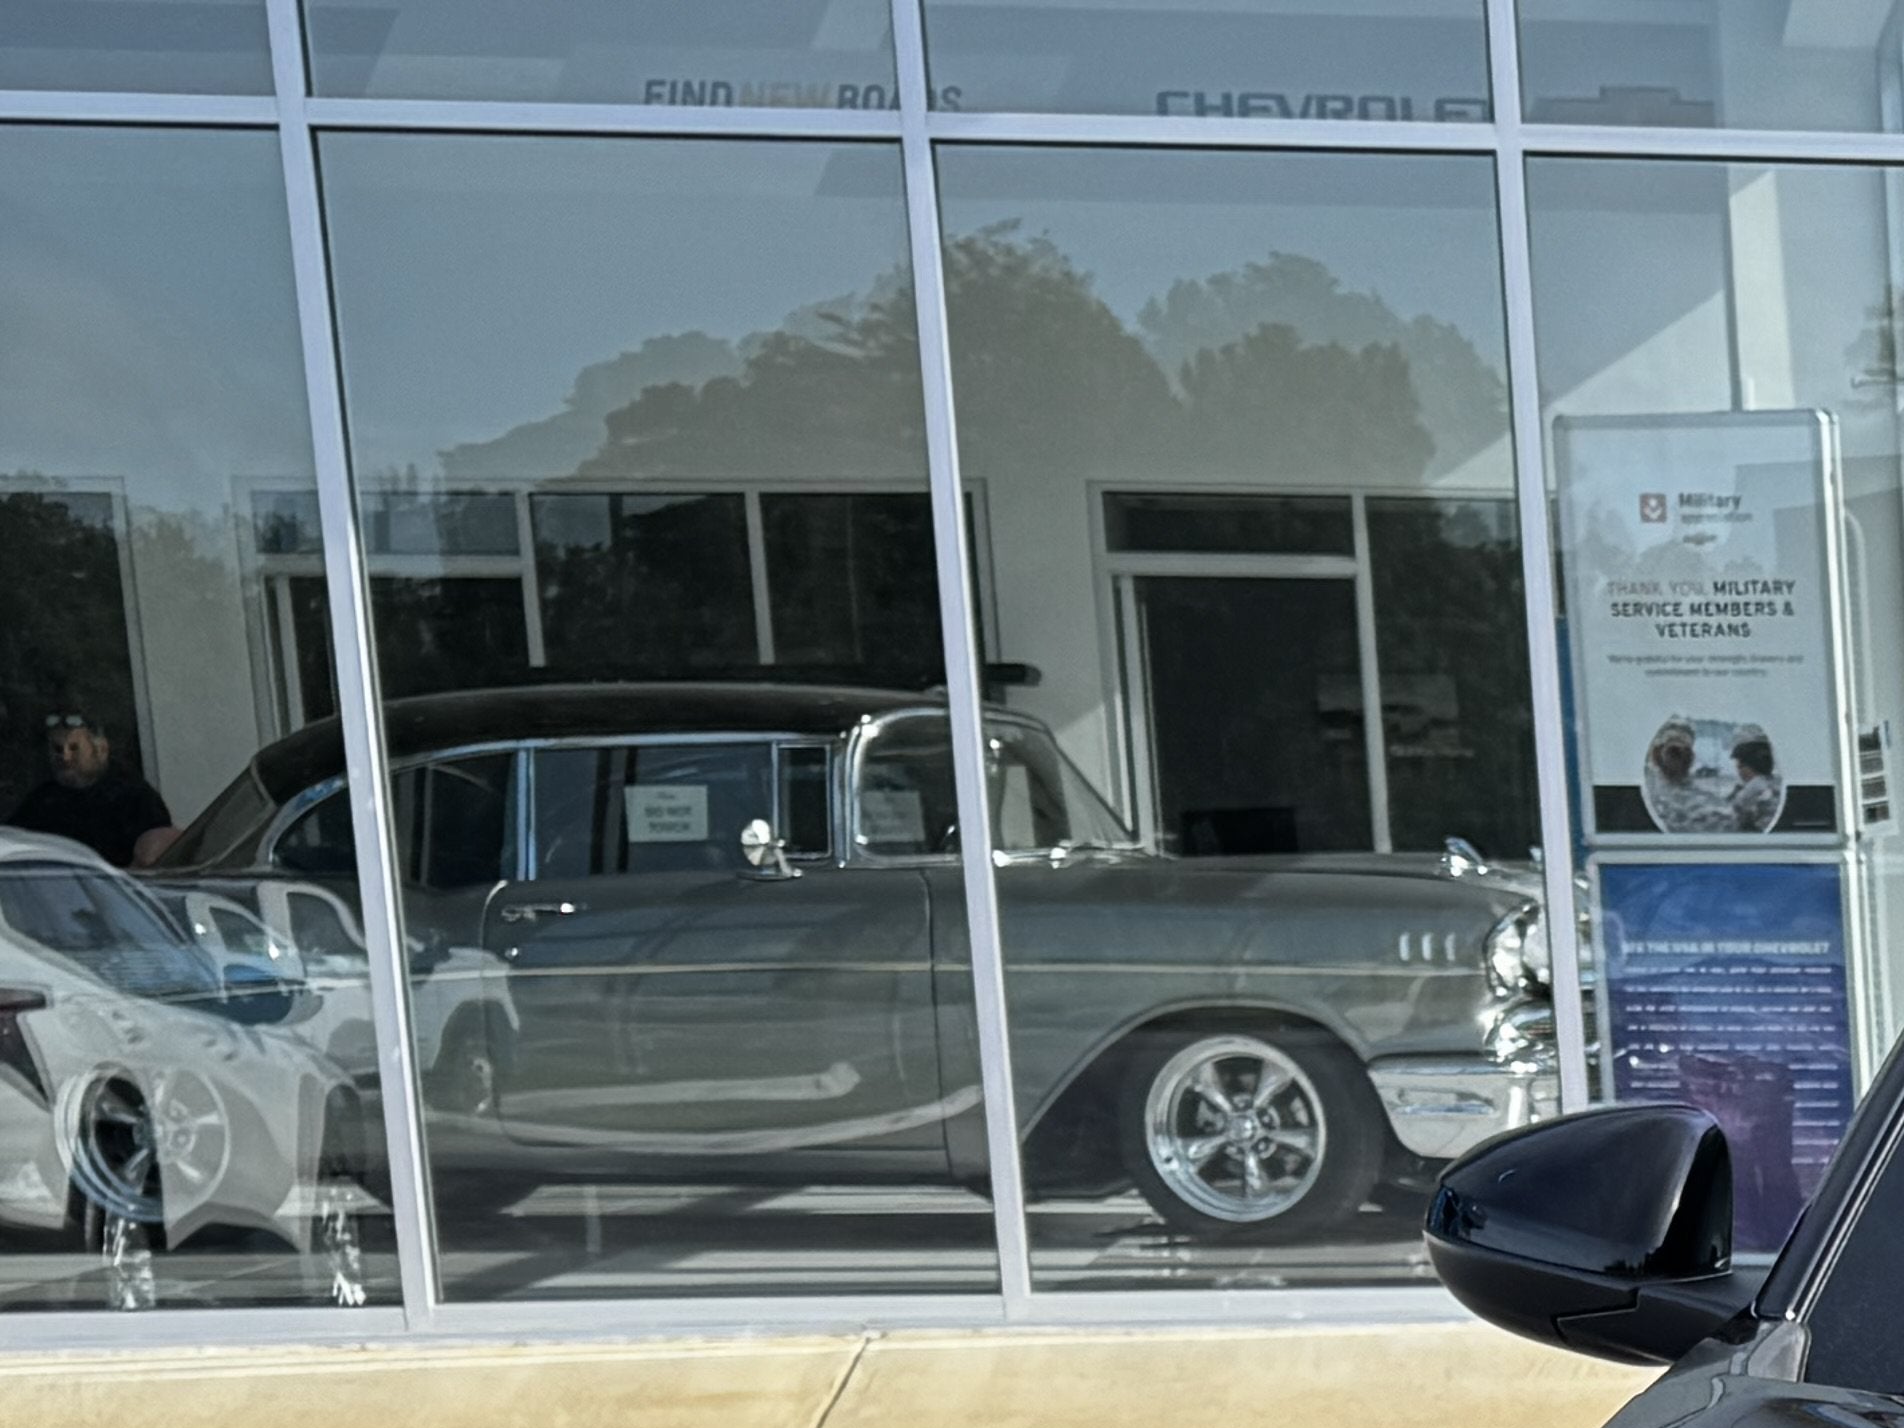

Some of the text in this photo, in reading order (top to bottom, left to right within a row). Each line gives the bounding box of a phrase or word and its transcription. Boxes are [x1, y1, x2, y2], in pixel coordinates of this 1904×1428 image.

[837, 83, 962, 112] ROS
[1678, 492, 1742, 510] Military
[1713, 579, 1796, 596] MILITARY
[1610, 601, 1796, 618] SERVICE MEMBERS &
[1654, 622, 1752, 638] VETERANS
